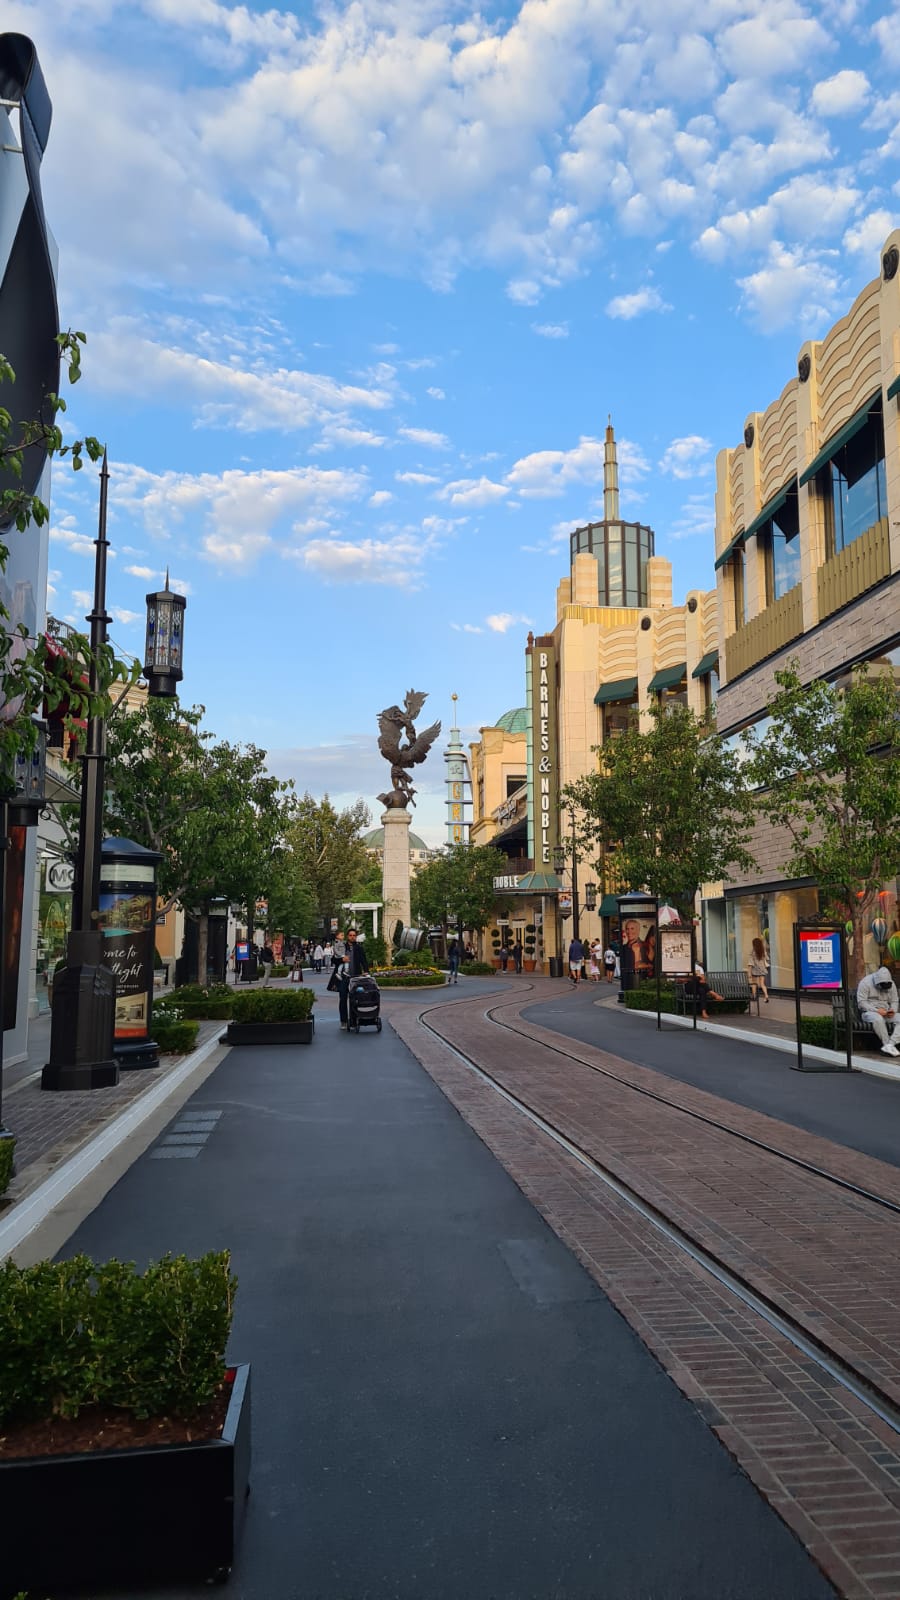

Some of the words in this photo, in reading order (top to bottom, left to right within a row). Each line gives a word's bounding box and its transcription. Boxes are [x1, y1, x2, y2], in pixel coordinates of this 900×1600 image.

[539, 652, 549, 750] BARNES
[539, 756, 551, 773] &
[541, 777, 550, 863] NOBLE
